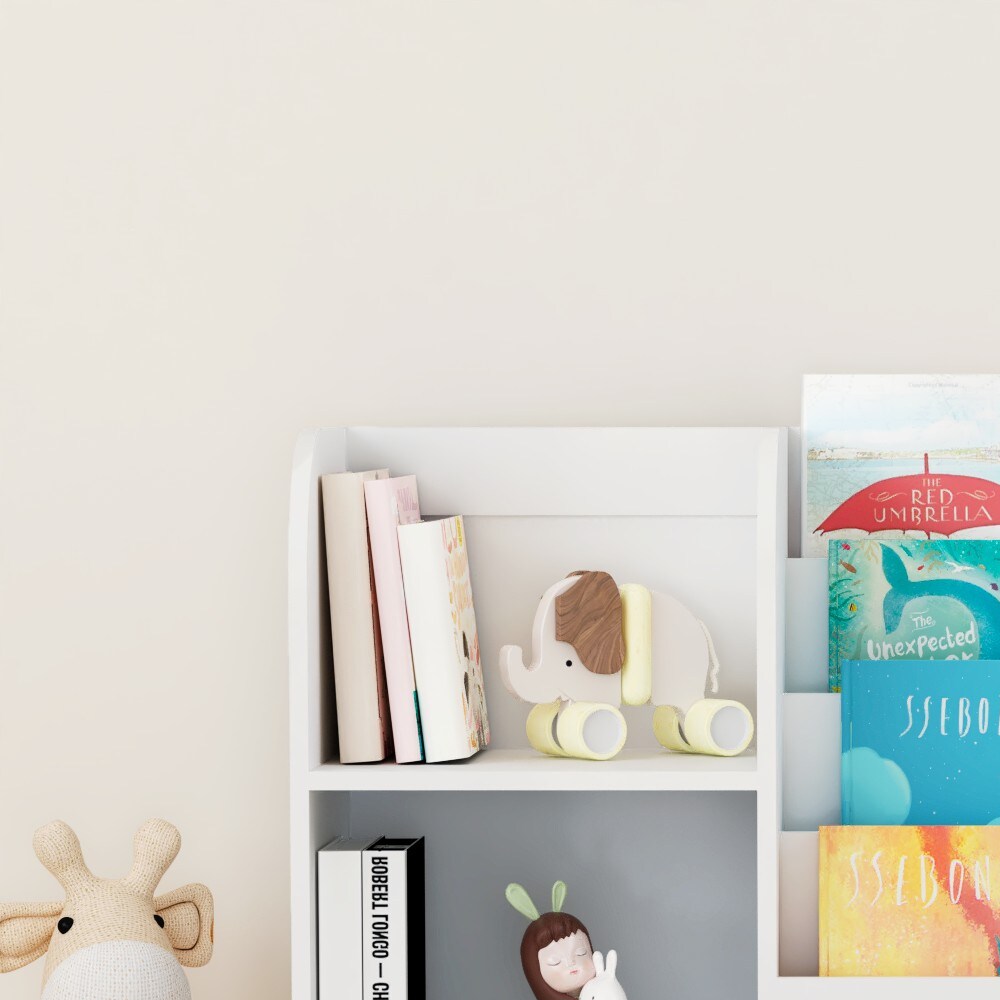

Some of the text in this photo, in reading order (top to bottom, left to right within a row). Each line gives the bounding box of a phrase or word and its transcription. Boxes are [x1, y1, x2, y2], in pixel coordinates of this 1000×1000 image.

[922, 478, 941, 487] THE
[911, 488, 953, 505] RED
[873, 505, 992, 525] UMBRELLA
[914, 615, 933, 627] The
[867, 621, 977, 660] Unexpected
